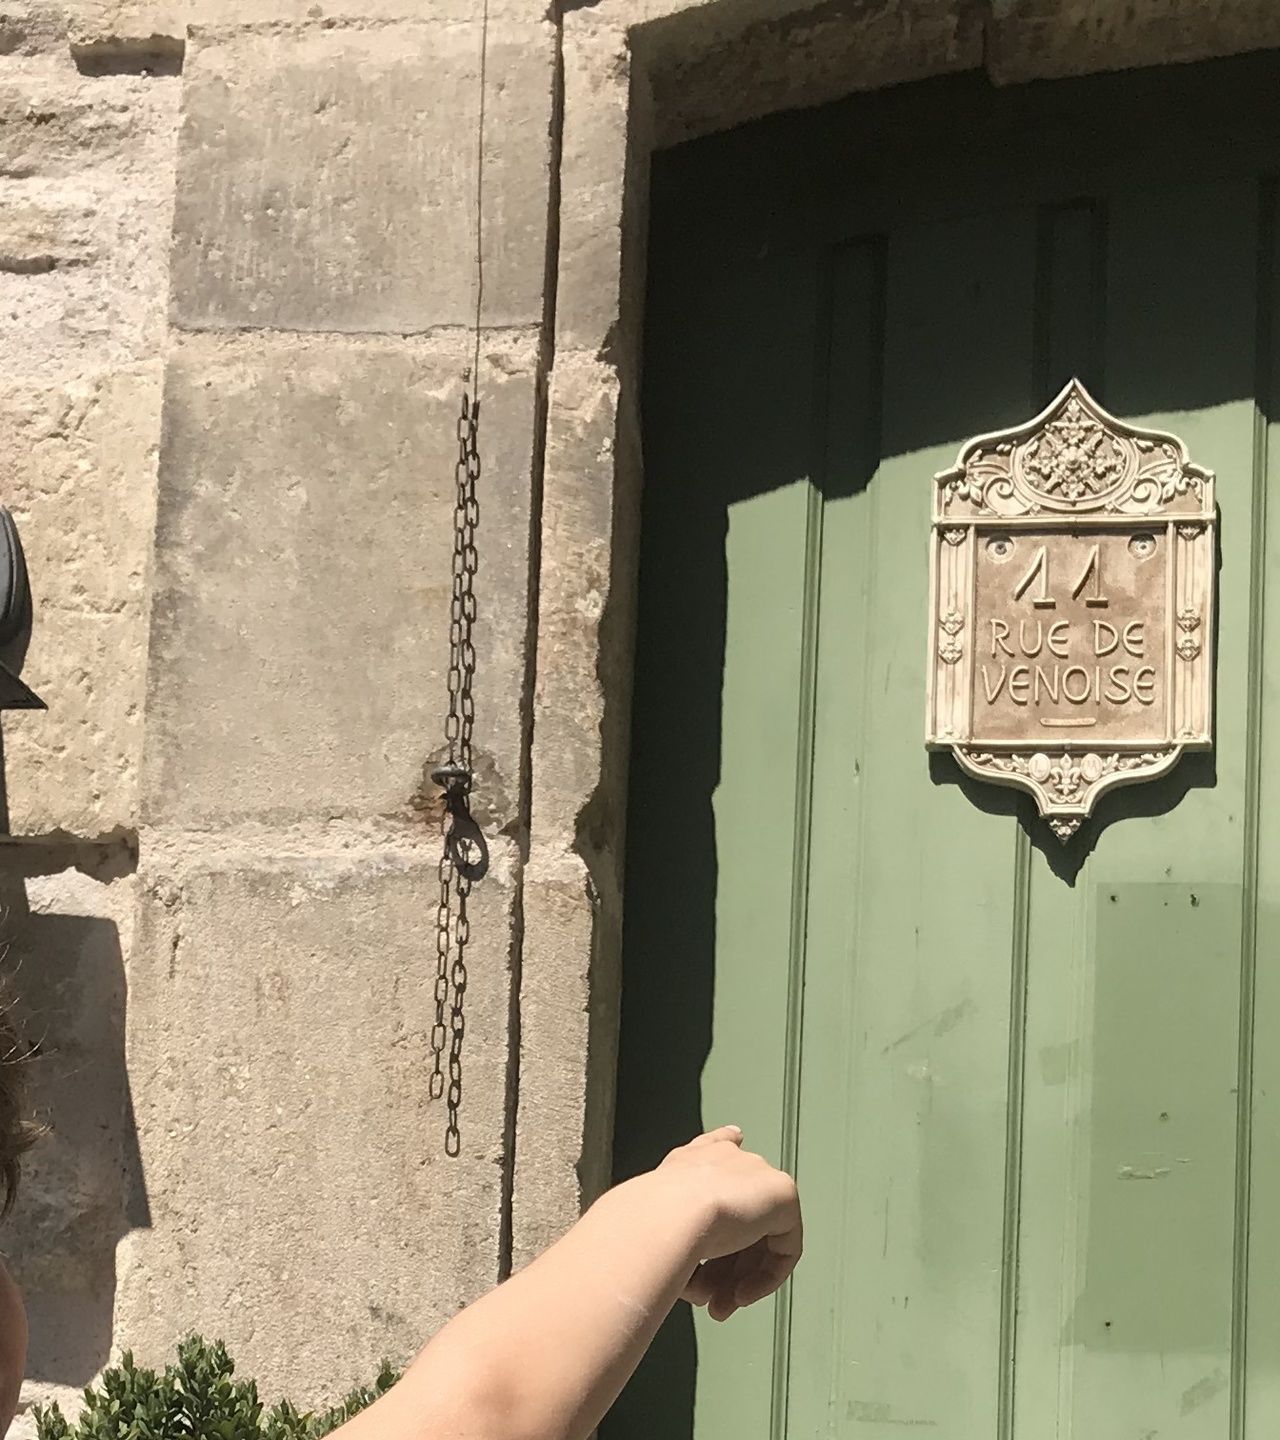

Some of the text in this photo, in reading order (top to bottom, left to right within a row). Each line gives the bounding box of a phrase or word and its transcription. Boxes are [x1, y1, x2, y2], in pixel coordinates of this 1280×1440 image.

[1014, 545, 1109, 609] 11
[990, 618, 1145, 658] RUE DE
[981, 664, 1156, 705] VENOISE
